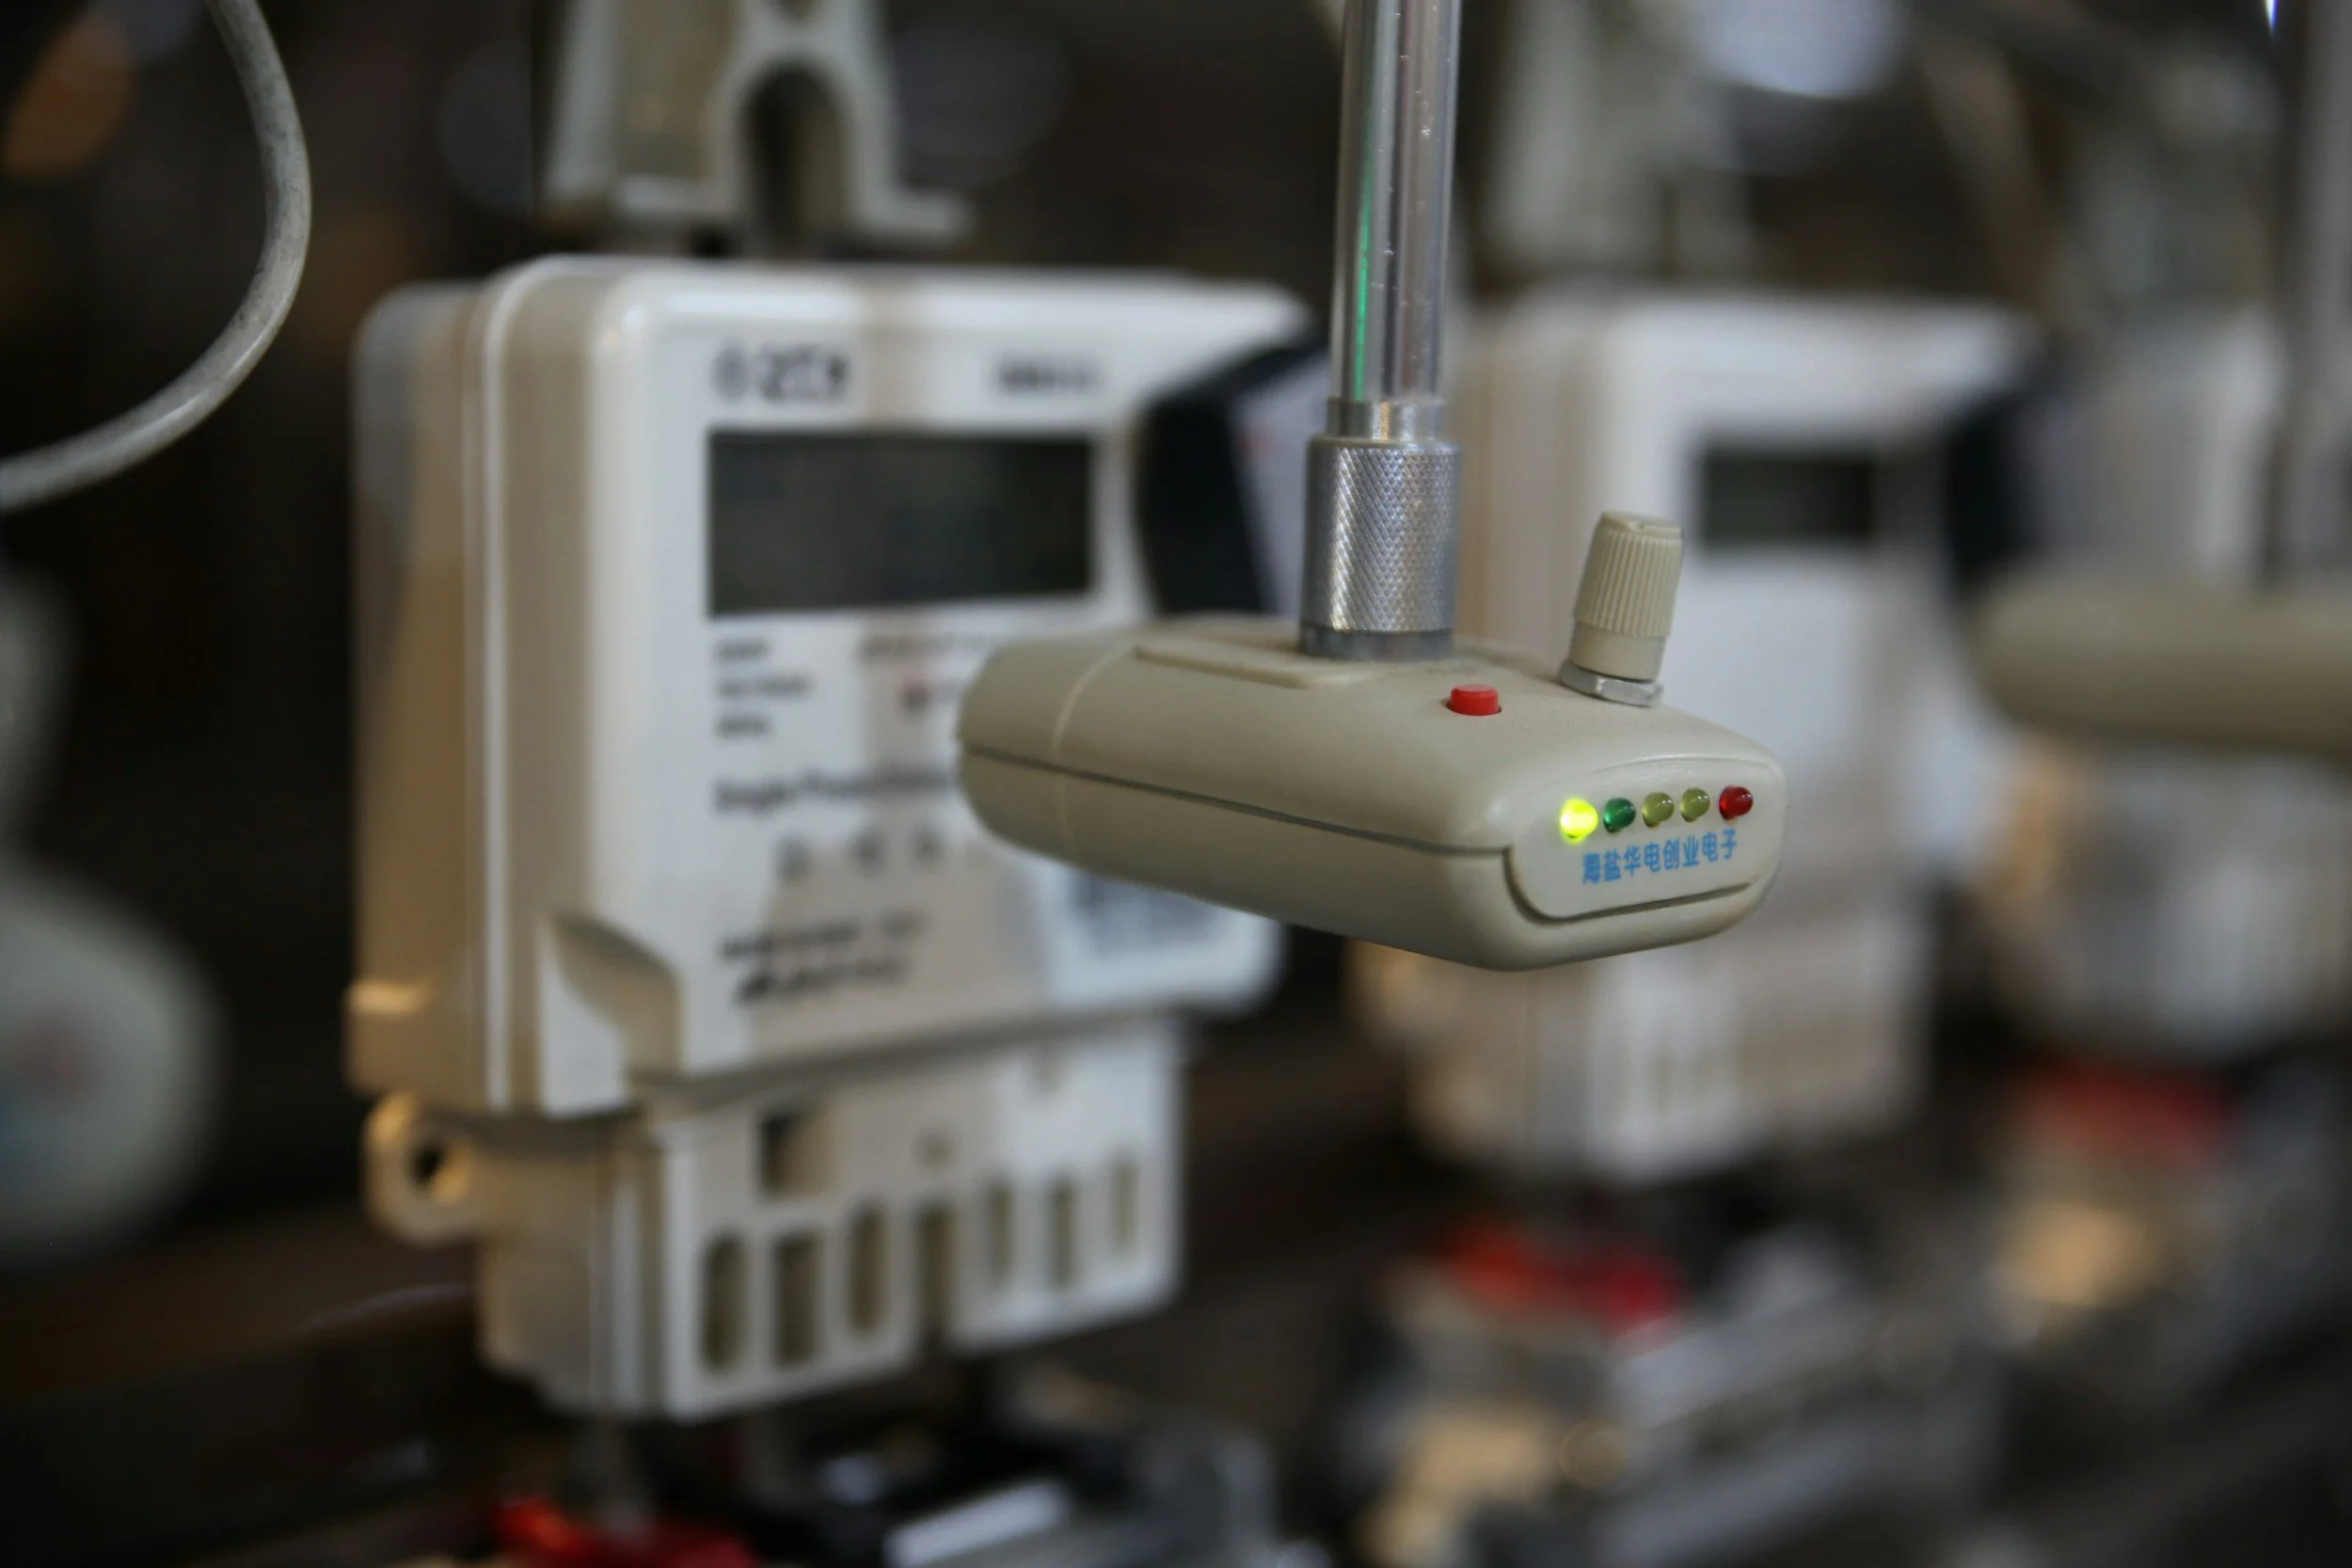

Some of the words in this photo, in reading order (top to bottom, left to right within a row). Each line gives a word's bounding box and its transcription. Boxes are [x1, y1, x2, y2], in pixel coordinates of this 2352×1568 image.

[1582, 829, 1738, 884] 海盐华电创业电子
